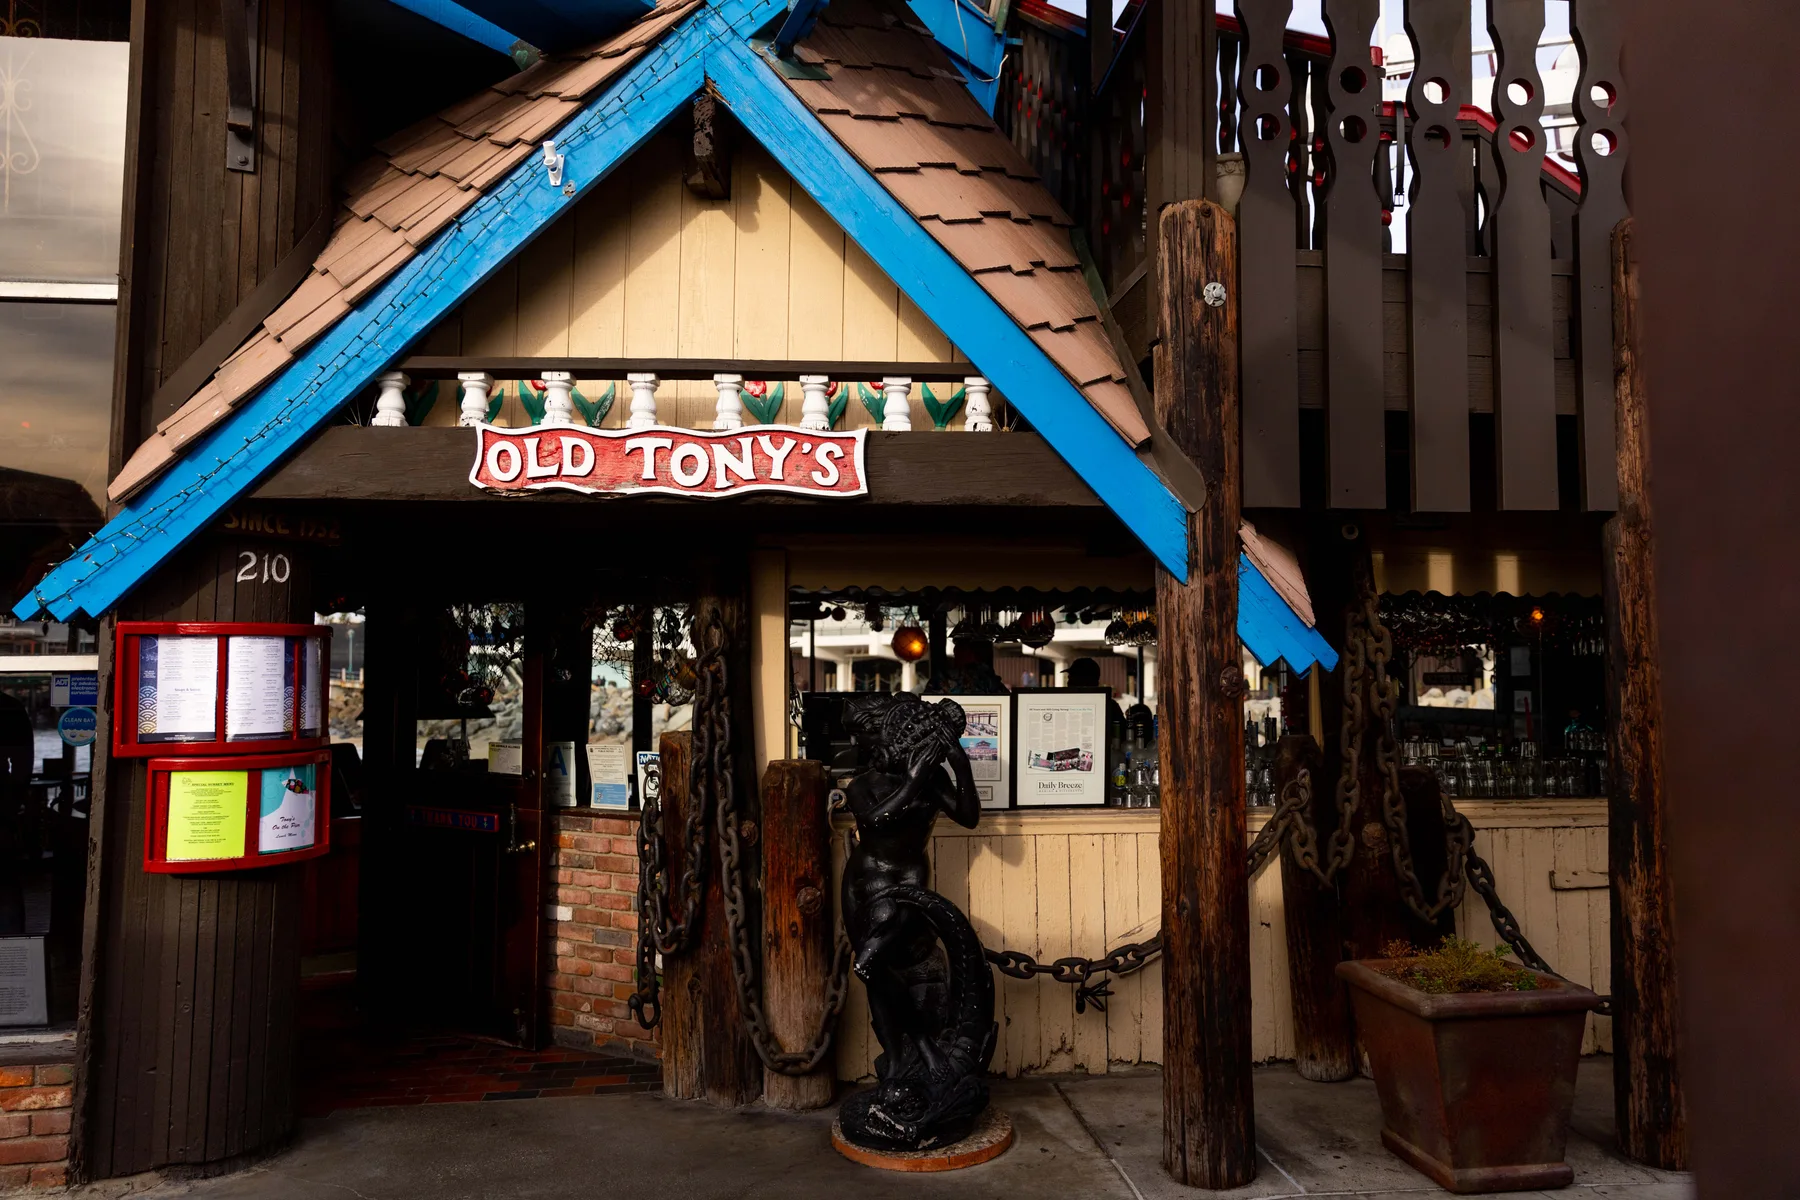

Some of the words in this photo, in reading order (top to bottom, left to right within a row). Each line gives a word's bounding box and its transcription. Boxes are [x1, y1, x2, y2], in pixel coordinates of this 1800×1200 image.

[486, 436, 595, 482] OLD
[624, 434, 845, 489] TONY'S
[222, 508, 290, 535] SINCE
[299, 517, 341, 539] 1952
[236, 550, 291, 584] 210
[55, 678, 68, 687] ADT
[549, 746, 568, 776] A
[1038, 781, 1057, 791] Daily
[1058, 781, 1083, 789] Breeze
[459, 813, 479, 829] YOU
